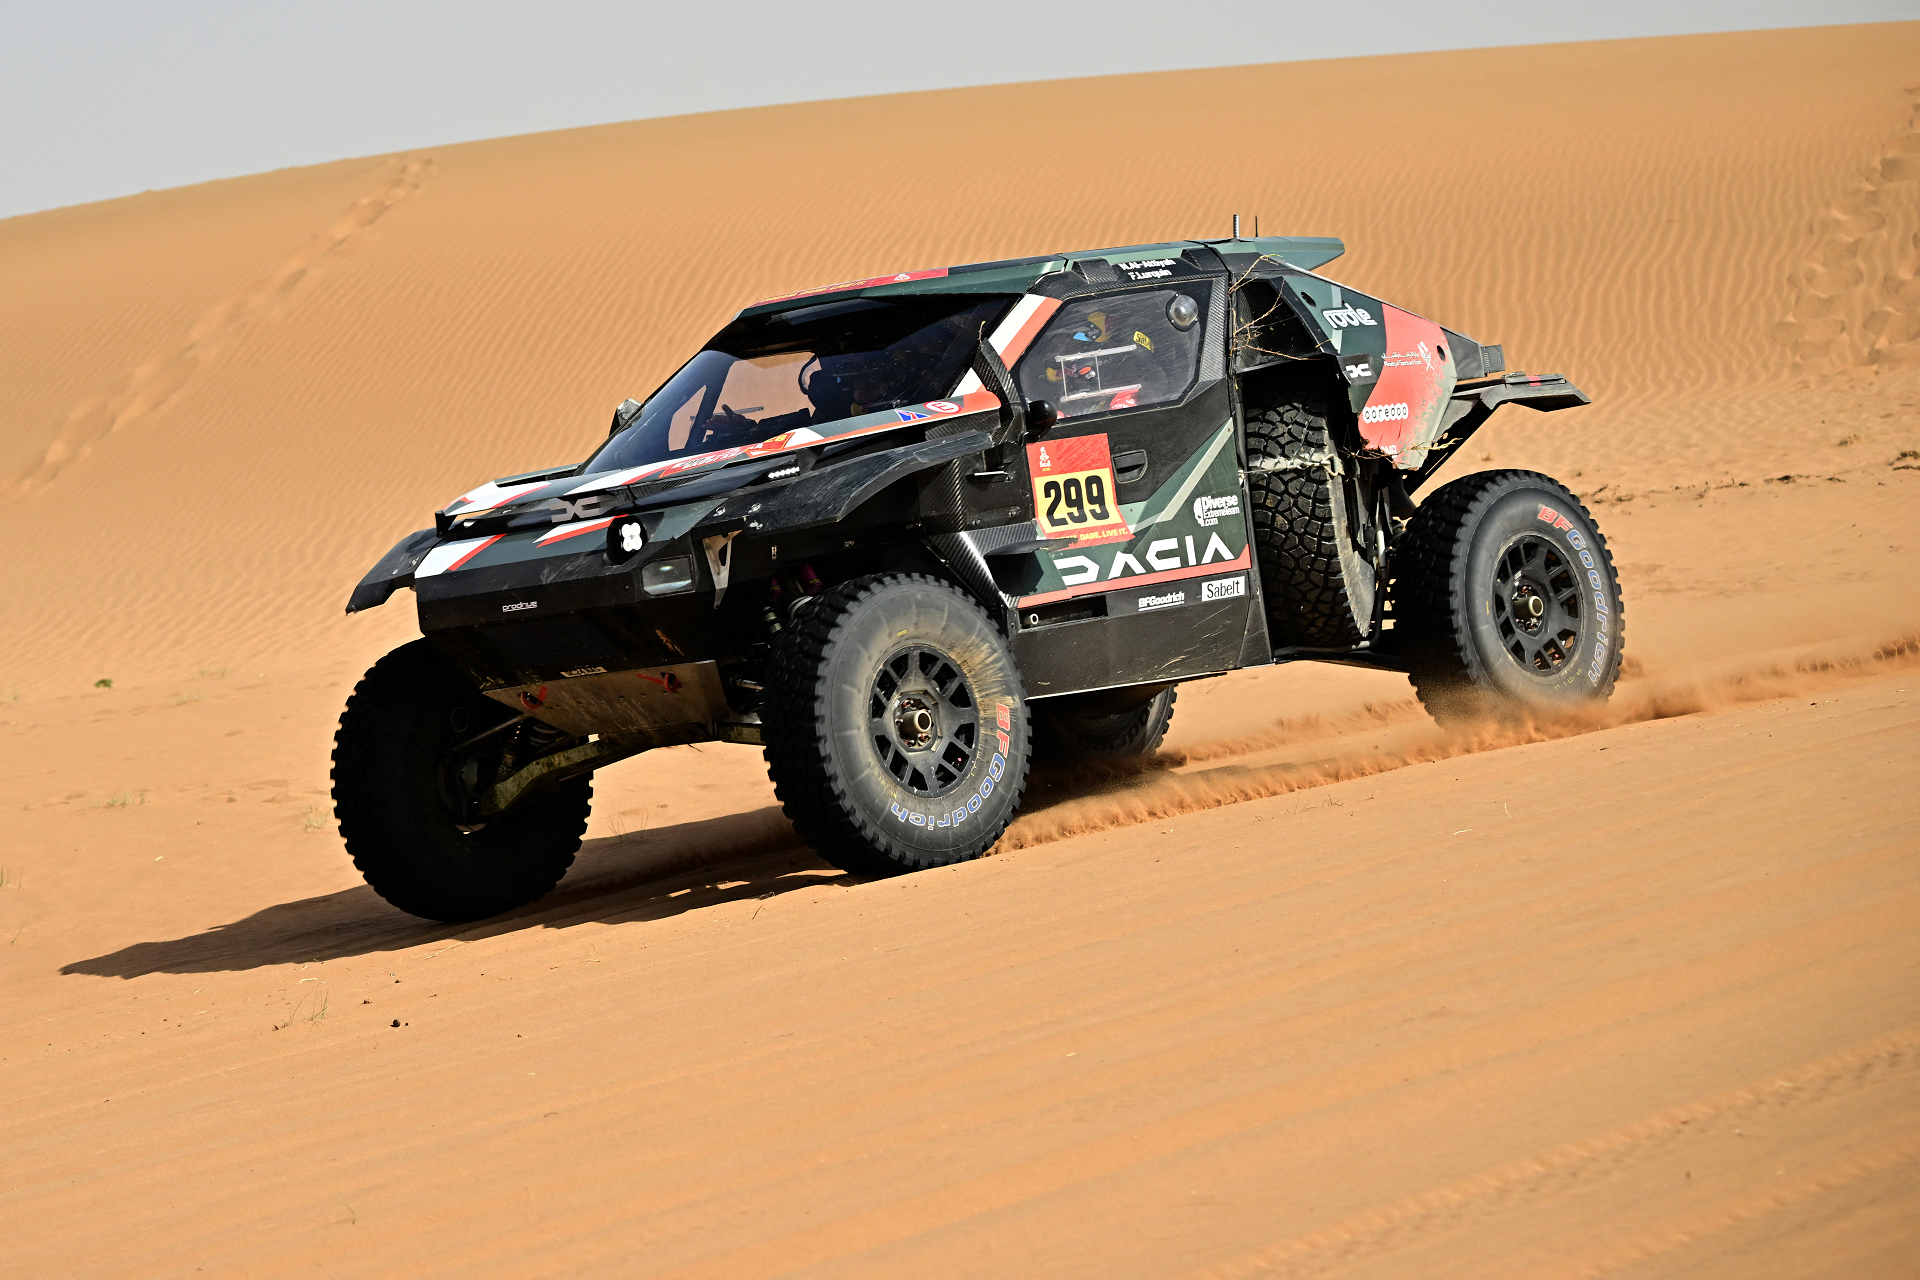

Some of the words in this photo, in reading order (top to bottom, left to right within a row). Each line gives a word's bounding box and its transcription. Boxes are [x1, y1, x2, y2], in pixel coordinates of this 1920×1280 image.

[1364, 403, 1408, 421] ooredoo
[1043, 474, 1110, 527] 299
[1201, 494, 1239, 510] Diverse
[1204, 518, 1219, 527] .com
[1079, 531, 1102, 541] DARE.
[1102, 529, 1118, 538] LIVE
[1118, 527, 1129, 536] IT.
[1053, 531, 1235, 586] DACIA
[1206, 578, 1241, 599] Sabelt
[1537, 504, 1609, 682] BFGoodrich
[1138, 590, 1185, 608] BFGoodrich
[890, 702, 1011, 831] BFGoodrich
